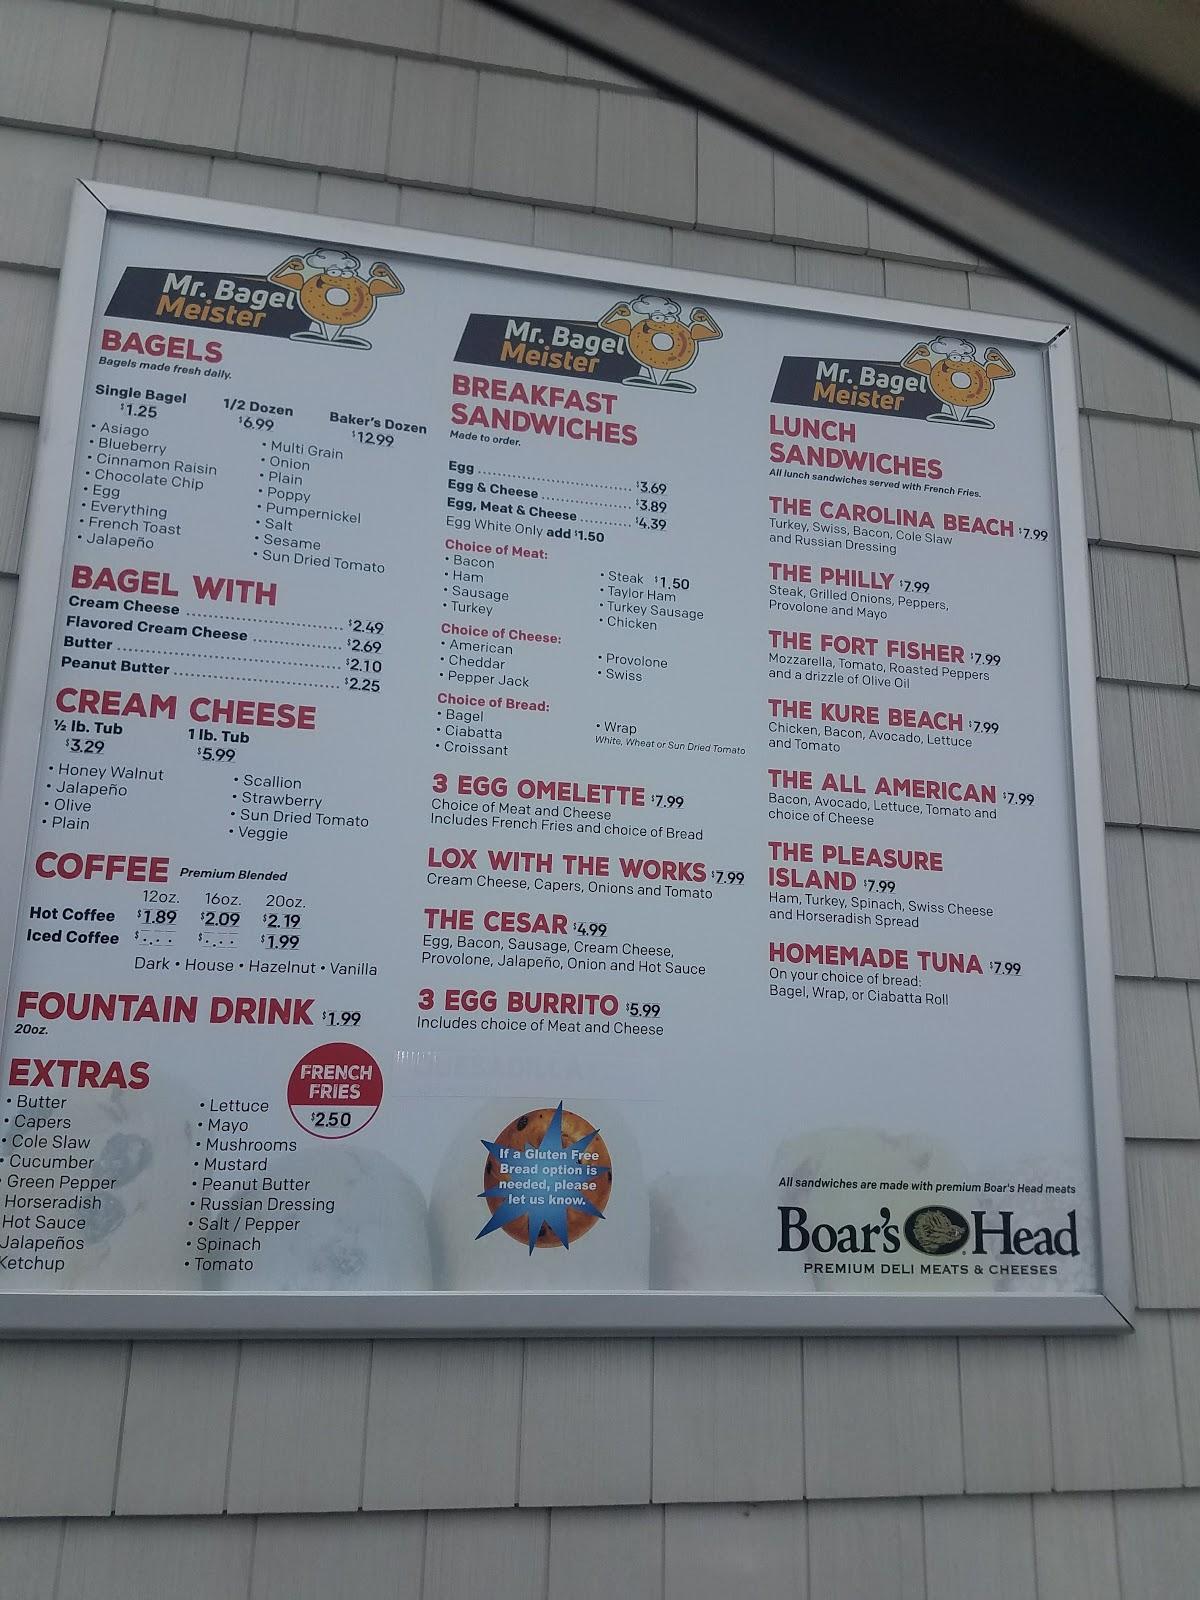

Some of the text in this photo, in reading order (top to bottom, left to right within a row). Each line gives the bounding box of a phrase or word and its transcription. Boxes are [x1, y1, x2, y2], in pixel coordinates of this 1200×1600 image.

[162, 272, 296, 312] Mr. Bagel
[155, 294, 267, 329] Meister
[101, 328, 223, 366] BAGELS
[504, 319, 625, 357] Mr. Bagel
[98, 356, 232, 381] Bagels made fresh daily.
[499, 341, 601, 374] Meister
[815, 360, 928, 395] Mr. Bagel
[95, 383, 187, 405] Single Bagel
[223, 398, 294, 417] 1/2 Dozen
[451, 373, 618, 415] BREAKFAST
[812, 381, 905, 412] Meister
[329, 411, 427, 435] Baker's Dozen
[450, 402, 639, 447] SANDWICHES
[769, 414, 856, 444] LUNCH
[271, 440, 343, 460] Multi Grain
[449, 429, 521, 447] Made to order.
[448, 460, 475, 476] Egg
[768, 441, 943, 482] SANDWICHES
[768, 467, 982, 498] All lunch sandwiches served with French Fries.
[90, 500, 168, 521] Everything
[266, 501, 361, 524] Pumpernickel
[768, 495, 812, 517] THE
[819, 501, 936, 530] CAROLINA
[943, 513, 1014, 538] BEACH
[768, 517, 953, 545] Turkey, Swiss, Bacon, Cole Slaw
[445, 538, 548, 560] Choice of Meat:
[71, 564, 278, 607] BAGEL WITH
[608, 570, 644, 585] Steak
[768, 562, 812, 584] THE
[820, 566, 895, 591] PHILLY
[68, 595, 120, 610] Cream
[123, 599, 180, 615] Cheese
[768, 629, 812, 651] THE
[820, 634, 879, 657] FORT
[886, 639, 965, 664] FISHER
[55, 687, 317, 730] CREAM CHEESE
[70, 719, 90, 733] lb.
[93, 721, 123, 735] Tub
[595, 735, 746, 755] White, Wheat or Sun Dried Tomato
[58, 762, 165, 781] Honey Walnut
[431, 773, 448, 794] 3
[457, 774, 508, 798] EGG
[517, 778, 645, 807] OMELETTE
[767, 768, 813, 790] THE
[820, 772, 867, 794] ALL
[874, 776, 997, 804] AMERICAN
[241, 791, 323, 810] Strawberry
[35, 851, 288, 883] COFFEE Premium Blended
[427, 847, 478, 870] LOX
[487, 849, 553, 874] WITH
[562, 854, 610, 877] THE
[618, 857, 707, 883] WORKS
[767, 841, 944, 872] THE PLEASURE
[768, 866, 857, 891] ISLAND
[143, 889, 306, 909] 12oz. 16oz. 20oz.
[29, 906, 59, 920] Hot
[62, 907, 116, 922] Coffee
[423, 908, 474, 931] THE
[483, 910, 568, 935] CESAR
[769, 941, 909, 970] HOMEMADE
[916, 950, 984, 975] TUNA
[16, 990, 199, 1024] FOUNTAIN
[209, 996, 316, 1026] DRINK
[417, 988, 435, 1011] 3
[444, 989, 498, 1013] EGG
[507, 991, 619, 1017] BURRITO
[13, 1023, 49, 1035] 20oz.
[8, 1057, 150, 1090] EXTRAS
[300, 1064, 373, 1081] FRENCH
[309, 1083, 361, 1100] FRIES
[206, 1137, 297, 1152] Mushrooms
[499, 1148, 600, 1161] If a Gluten Free
[778, 1176, 1076, 1194] All sandwiches are made with premium Boar's Head meats
[777, 1205, 1081, 1258] Boar's Head
[803, 1262, 1058, 1276] PREMIUM DELI MEATS & CHEESES
